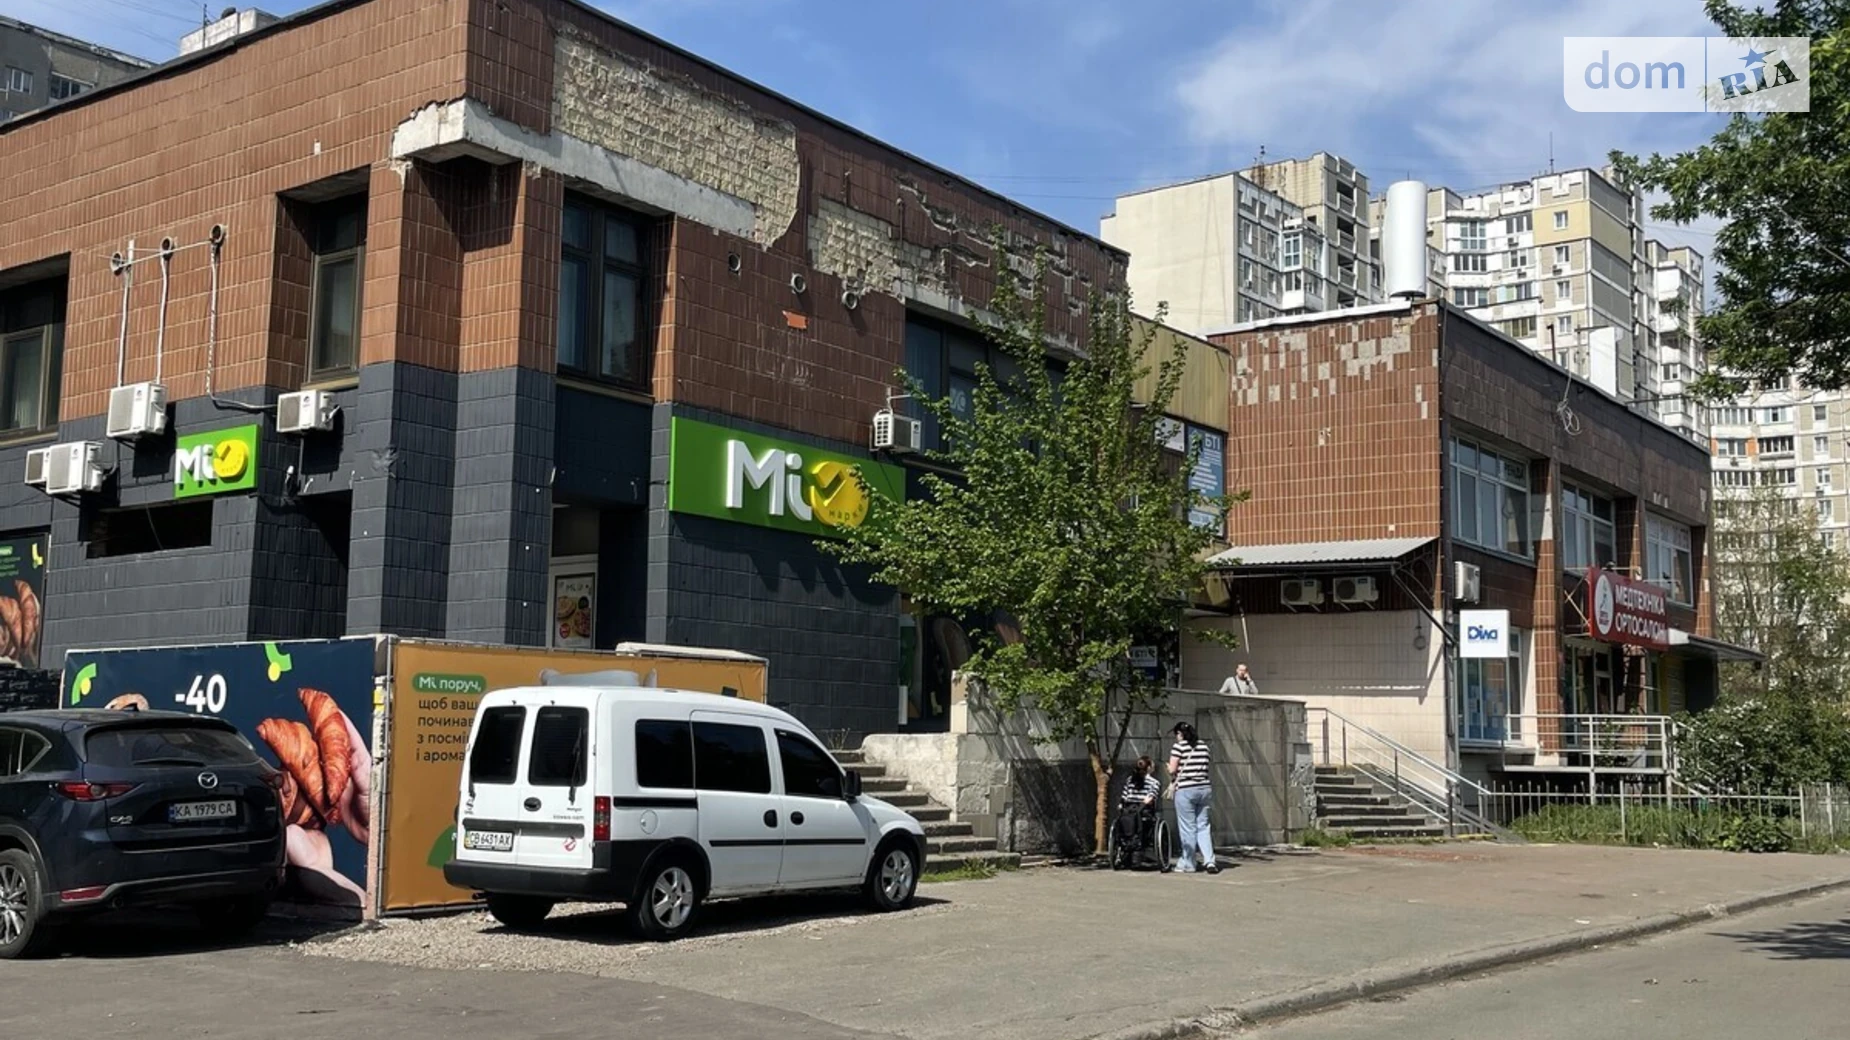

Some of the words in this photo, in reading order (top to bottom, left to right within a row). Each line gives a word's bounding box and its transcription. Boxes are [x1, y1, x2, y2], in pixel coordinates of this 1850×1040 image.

[829, 503, 863, 522] марке
[175, 673, 227, 713] -40
[439, 679, 481, 693] поруч,
[418, 696, 448, 711] щоб
[451, 699, 479, 711] ваш
[416, 733, 424, 744] з
[427, 731, 469, 745] посмі
[175, 805, 191, 817] KA
[194, 803, 216, 816] 1979
[218, 802, 234, 814] CA
